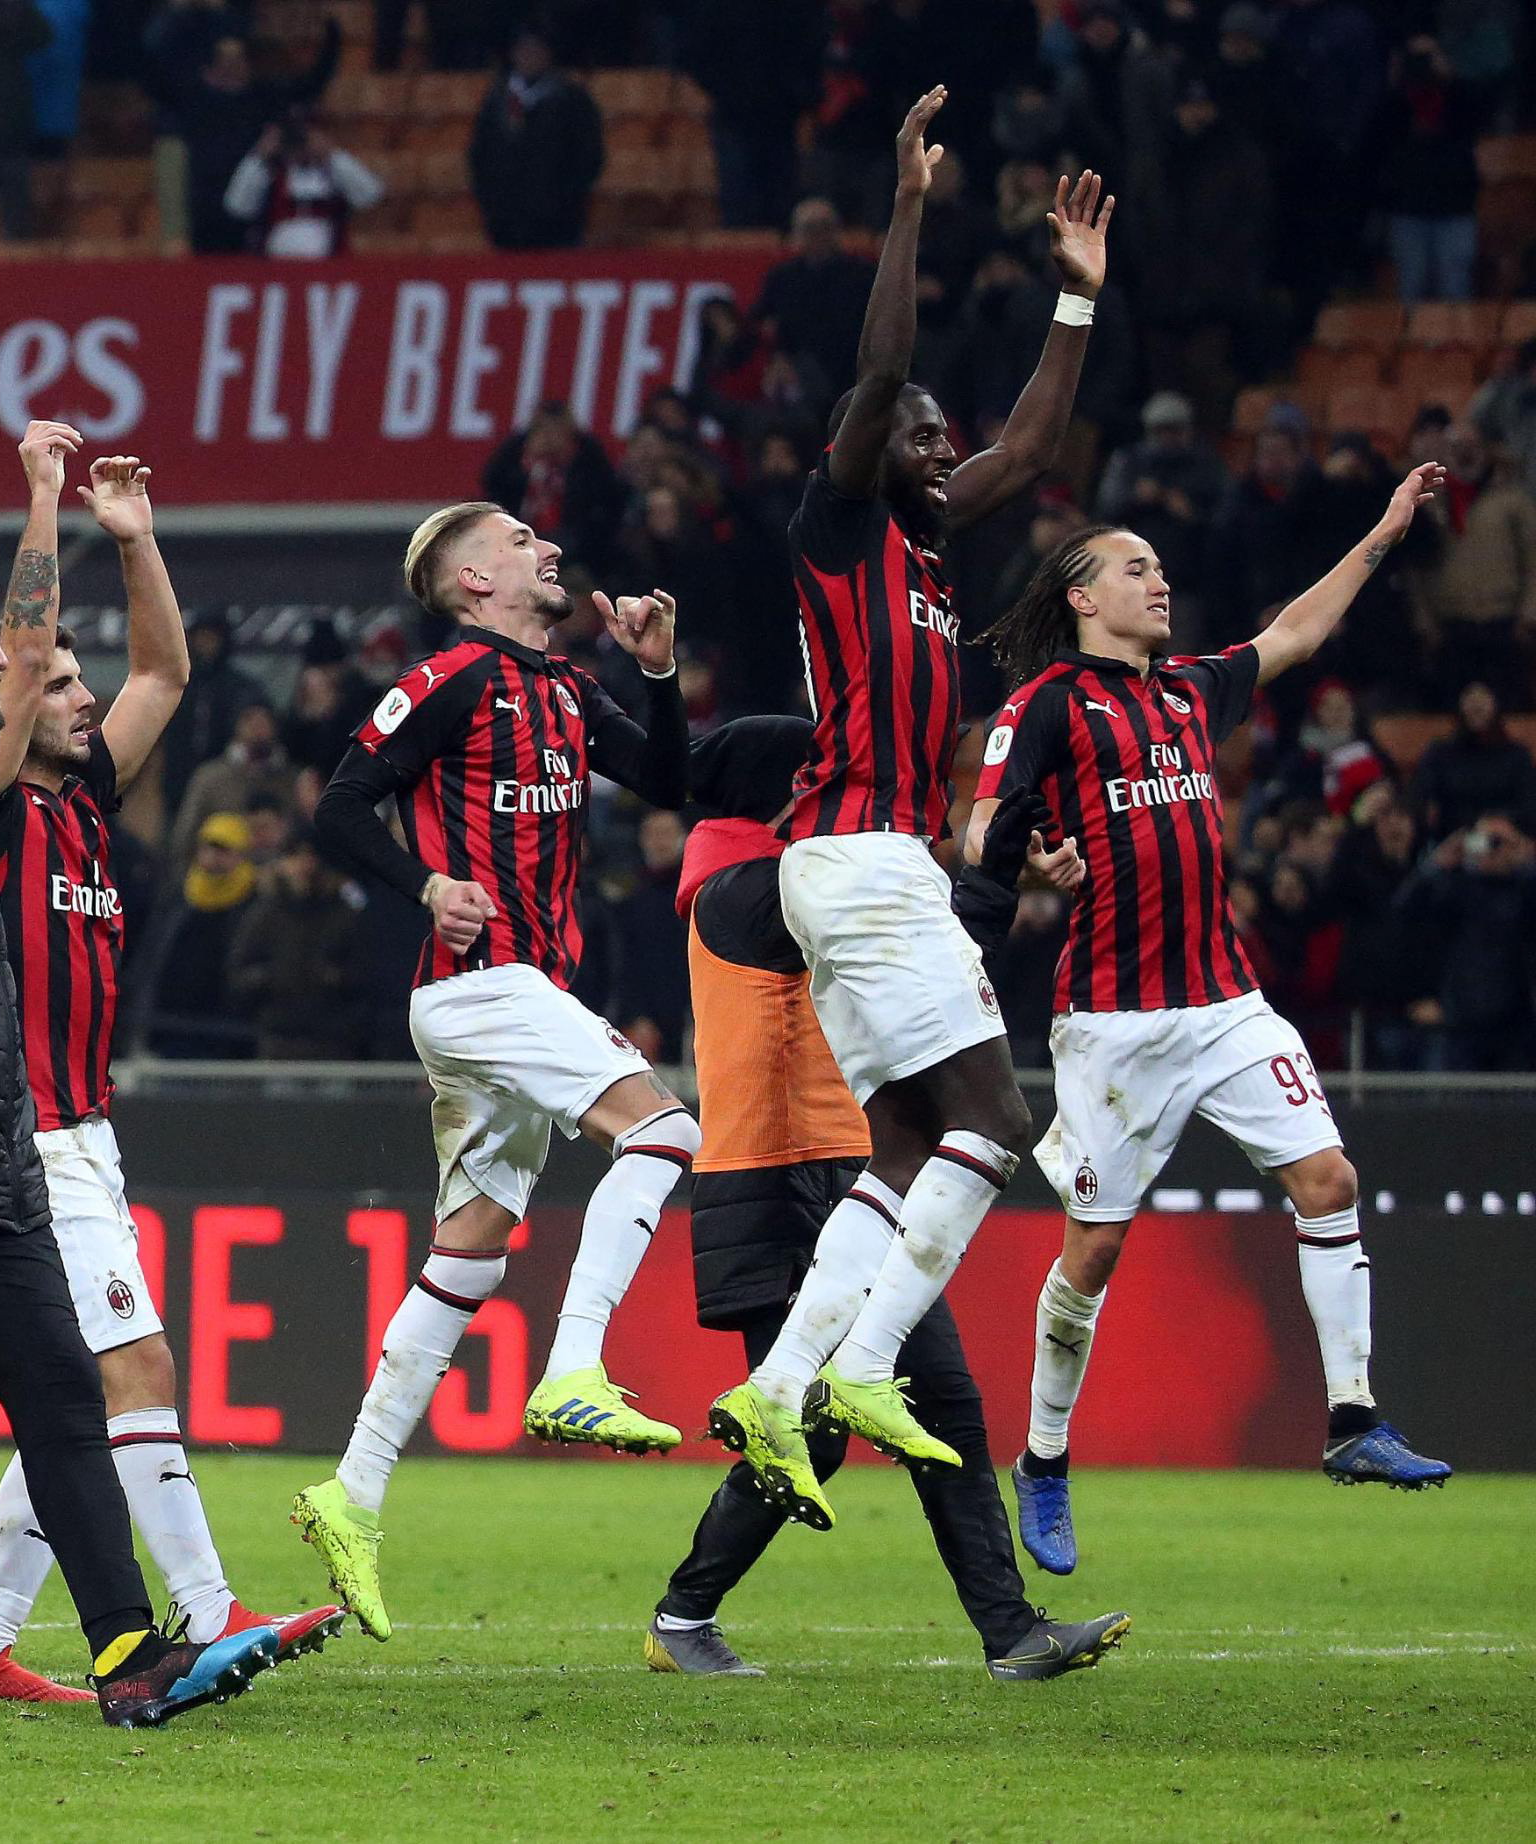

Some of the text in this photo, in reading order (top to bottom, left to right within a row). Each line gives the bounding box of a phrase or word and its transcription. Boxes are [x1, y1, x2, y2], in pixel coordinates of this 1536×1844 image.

[193, 283, 359, 443] FLY
[1150, 743, 1182, 770] Fly
[1106, 769, 1213, 813] Emirate
